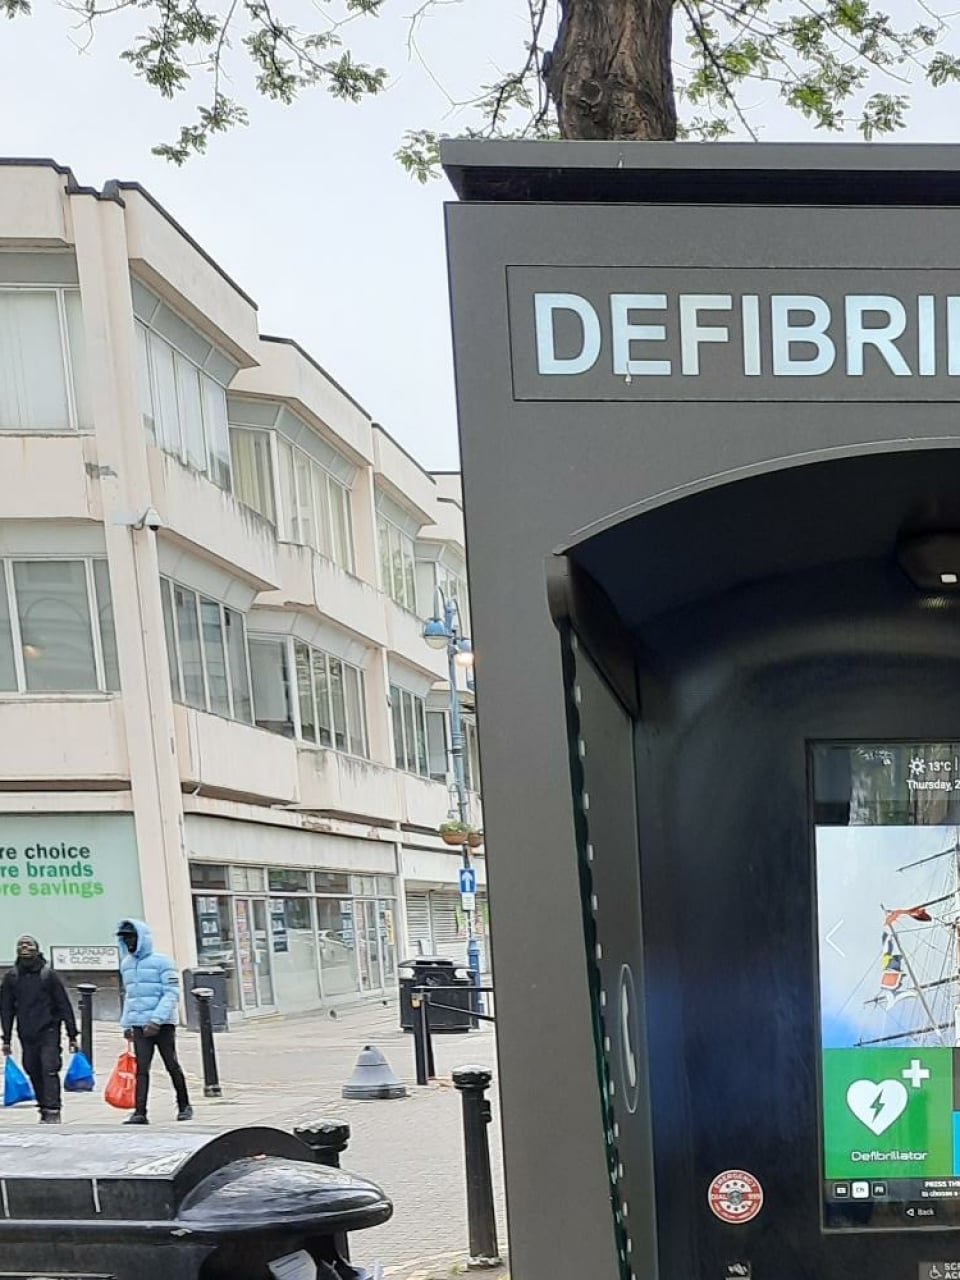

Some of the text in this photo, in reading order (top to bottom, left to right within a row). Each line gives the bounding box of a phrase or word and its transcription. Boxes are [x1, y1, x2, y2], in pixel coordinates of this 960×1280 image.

[906, 779, 952, 791] Thursday,
[24, 843, 91, 860] choice
[27, 861, 94, 878] brands
[0, 879, 104, 898] re savings
[851, 1150, 928, 1162] Defibrillator
